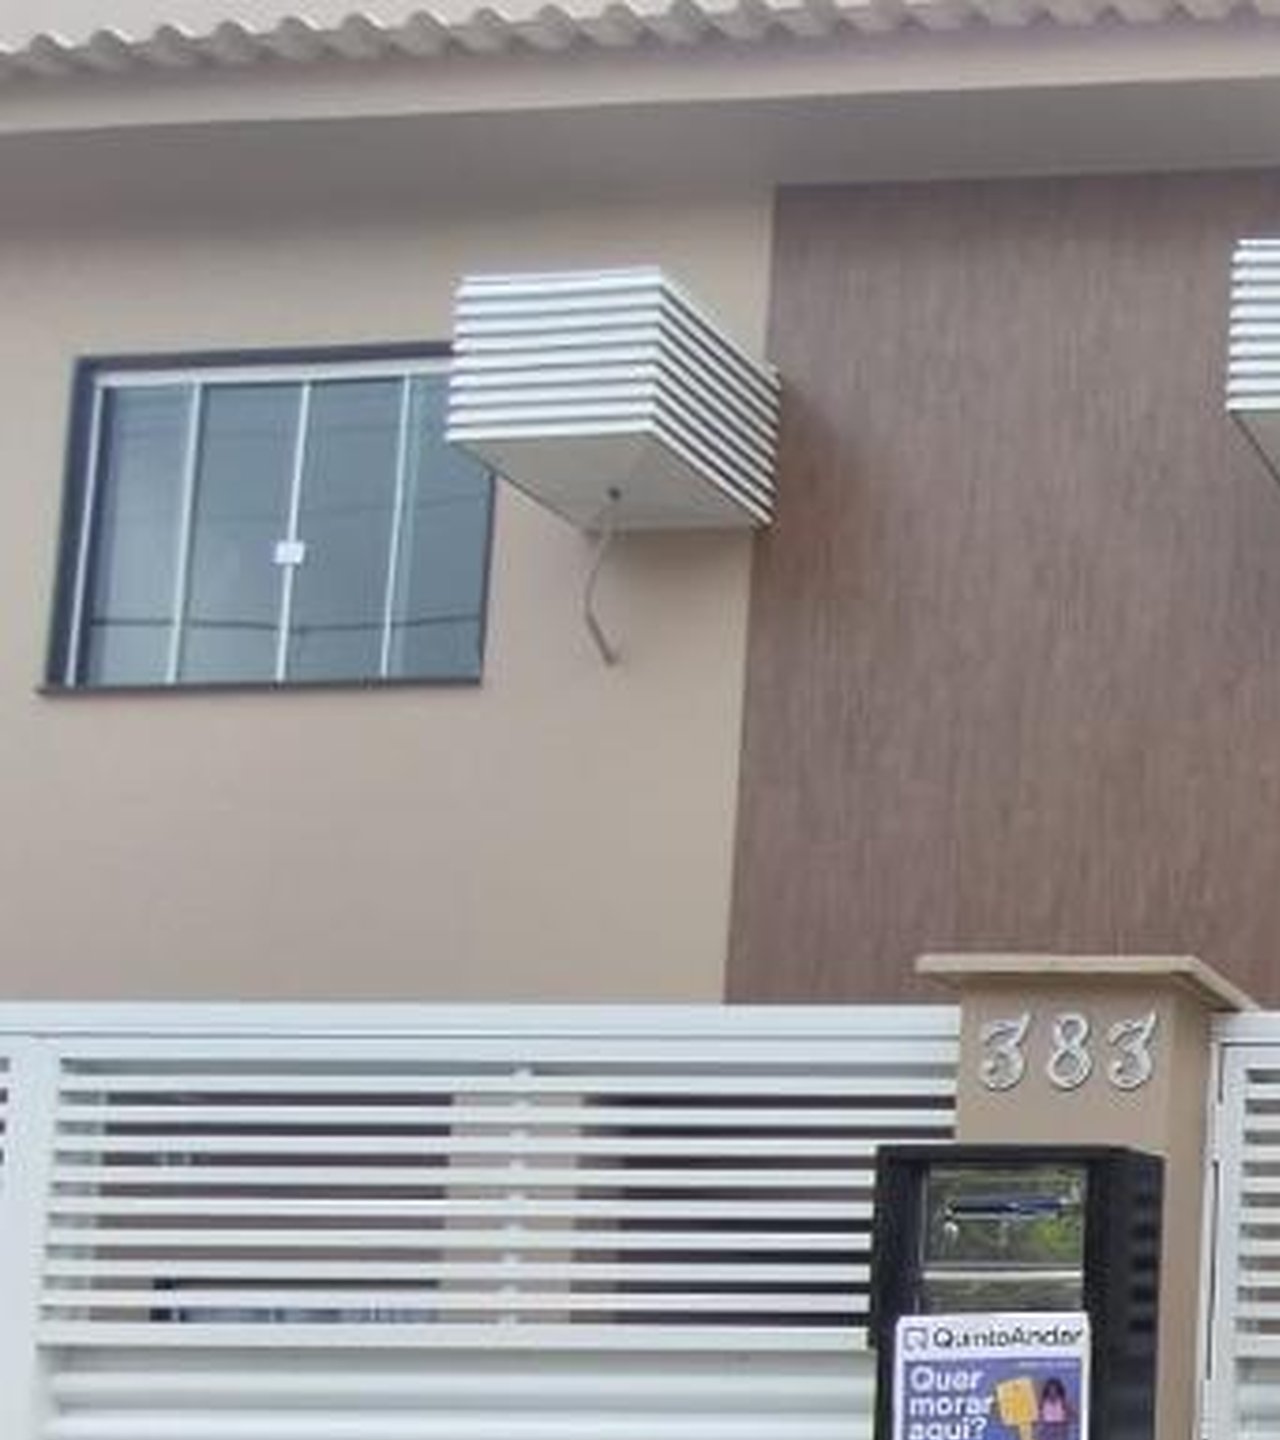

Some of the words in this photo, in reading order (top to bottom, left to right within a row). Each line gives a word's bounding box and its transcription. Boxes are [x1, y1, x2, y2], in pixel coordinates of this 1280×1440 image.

[980, 1011, 1156, 1091] 383
[909, 1365, 984, 1393] Quer
[908, 1395, 996, 1417] morar
